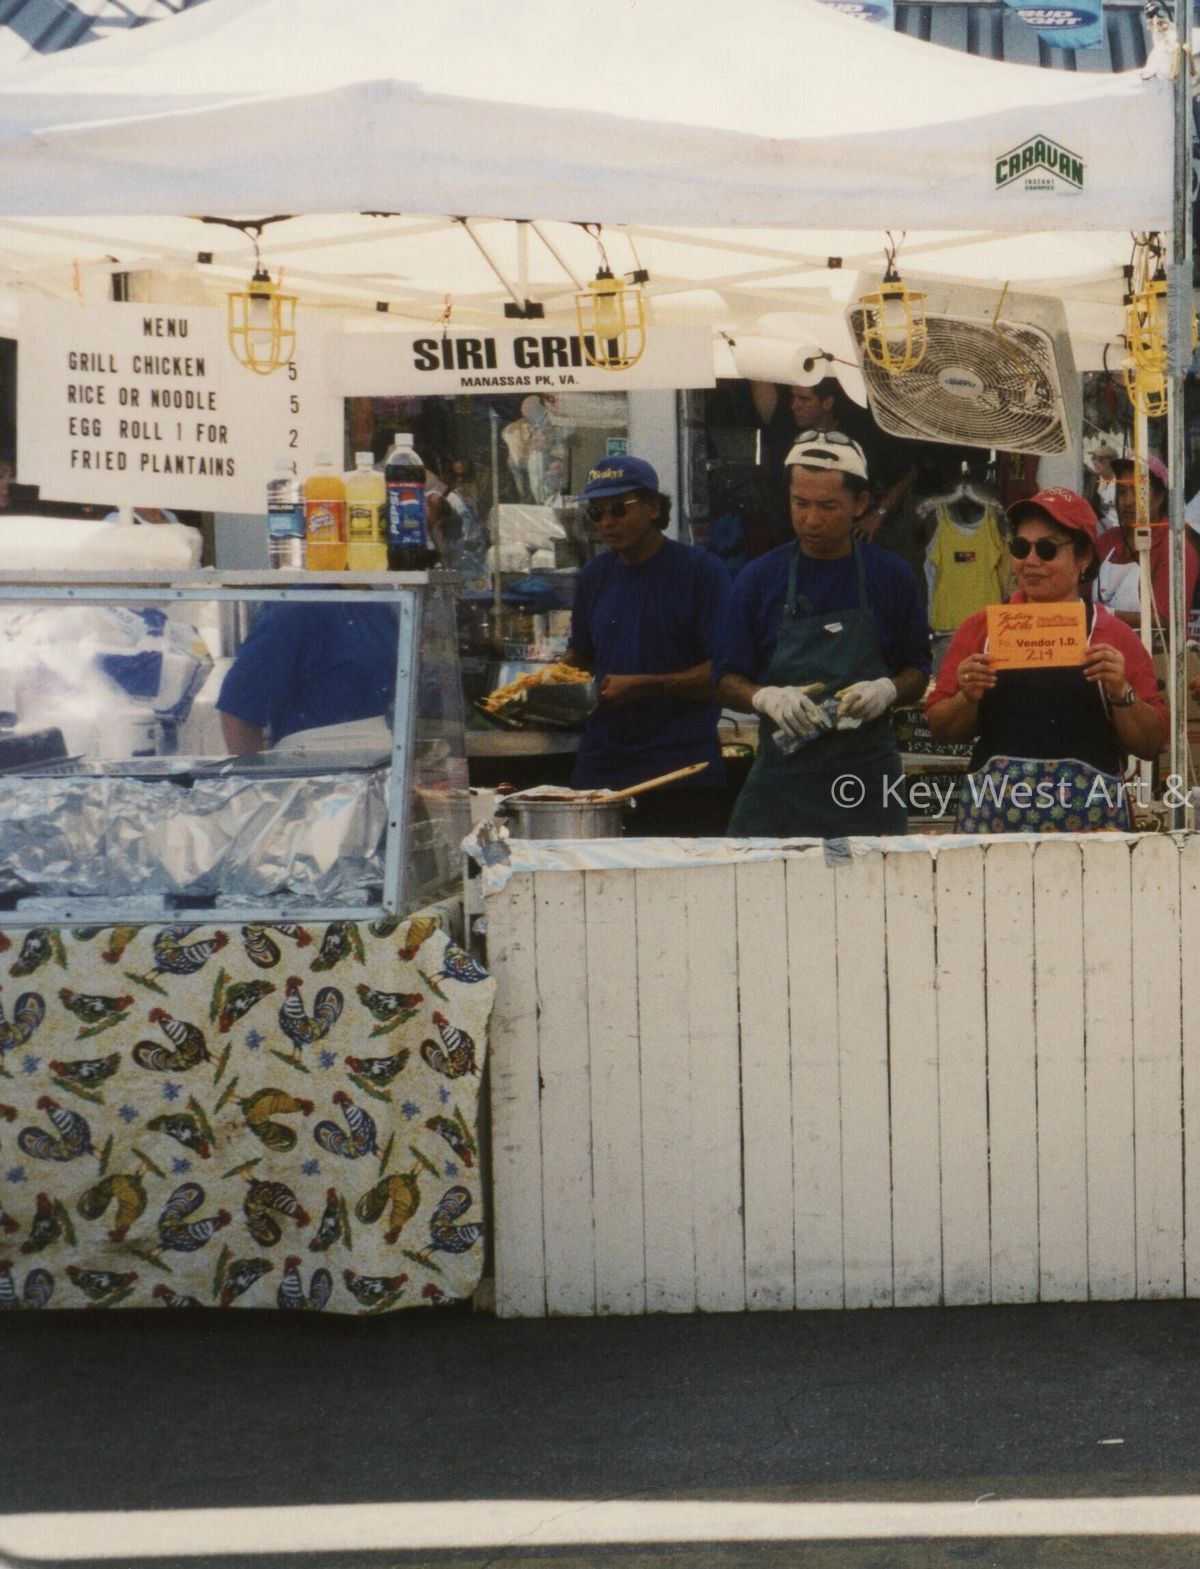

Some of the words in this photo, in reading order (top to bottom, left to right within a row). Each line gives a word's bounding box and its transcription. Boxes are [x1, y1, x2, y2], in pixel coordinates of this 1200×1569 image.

[995, 139, 1084, 186] CARAVAN
[142, 317, 189, 338] MENU
[68, 351, 118, 374] GRILL
[132, 354, 206, 378] CHICKEN
[287, 361, 298, 382] 5
[412, 336, 498, 372] SIRI
[460, 375, 531, 387] MANASSAS
[534, 375, 555, 387] PK,
[558, 374, 580, 386] VA.
[67, 384, 106, 404] RICE
[118, 387, 140, 407] OR
[150, 389, 217, 411] NOODLE
[289, 394, 300, 414] 5
[68, 416, 102, 437] EGG
[119, 419, 163, 441] ROLL
[196, 423, 229, 444] FOR
[288, 428, 299, 448] 2
[70, 448, 127, 472] FRIED
[140, 452, 236, 477] PLANTAINS
[390, 491, 400, 536] PEPSI
[1016, 638, 1056, 648] Vendor
[1059, 636, 1079, 647] I.D.
